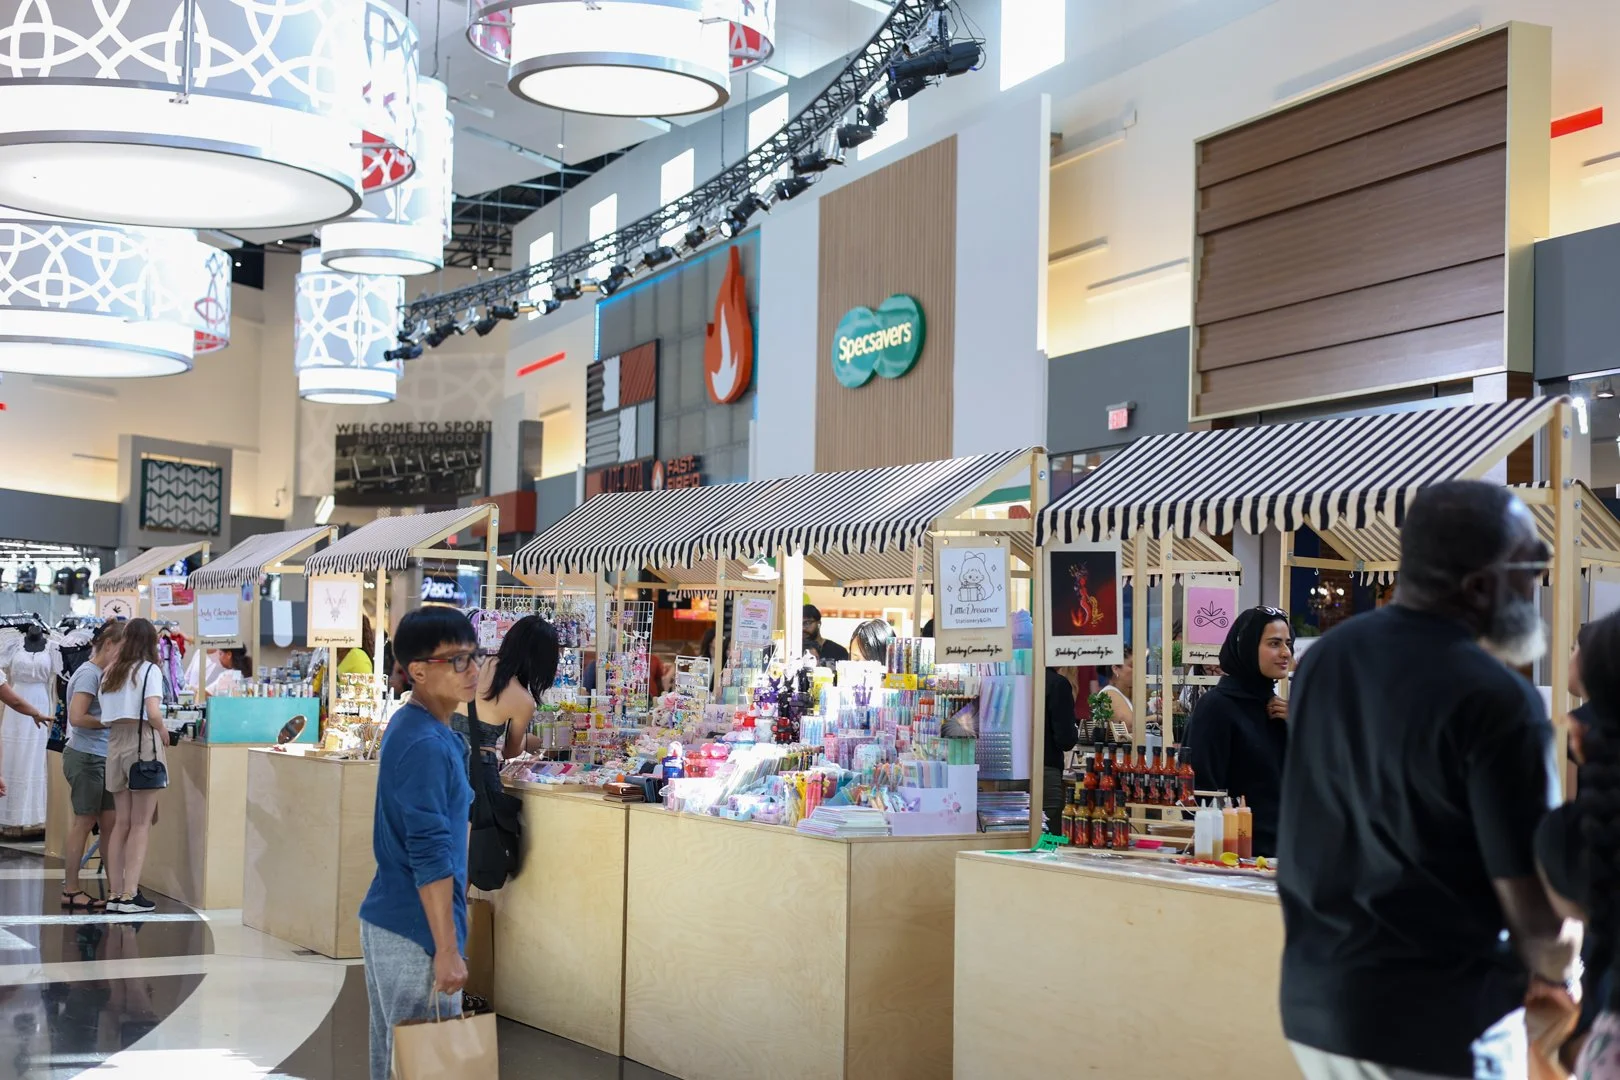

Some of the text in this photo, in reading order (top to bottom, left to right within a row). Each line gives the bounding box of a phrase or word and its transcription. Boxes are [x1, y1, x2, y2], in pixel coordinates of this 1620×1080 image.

[839, 322, 911, 364] Specsavers
[336, 420, 493, 434] WELCOME TO SPORT
[358, 432, 475, 445] NEIGHBOURHOOD
[966, 602, 1000, 615] Dreamer
